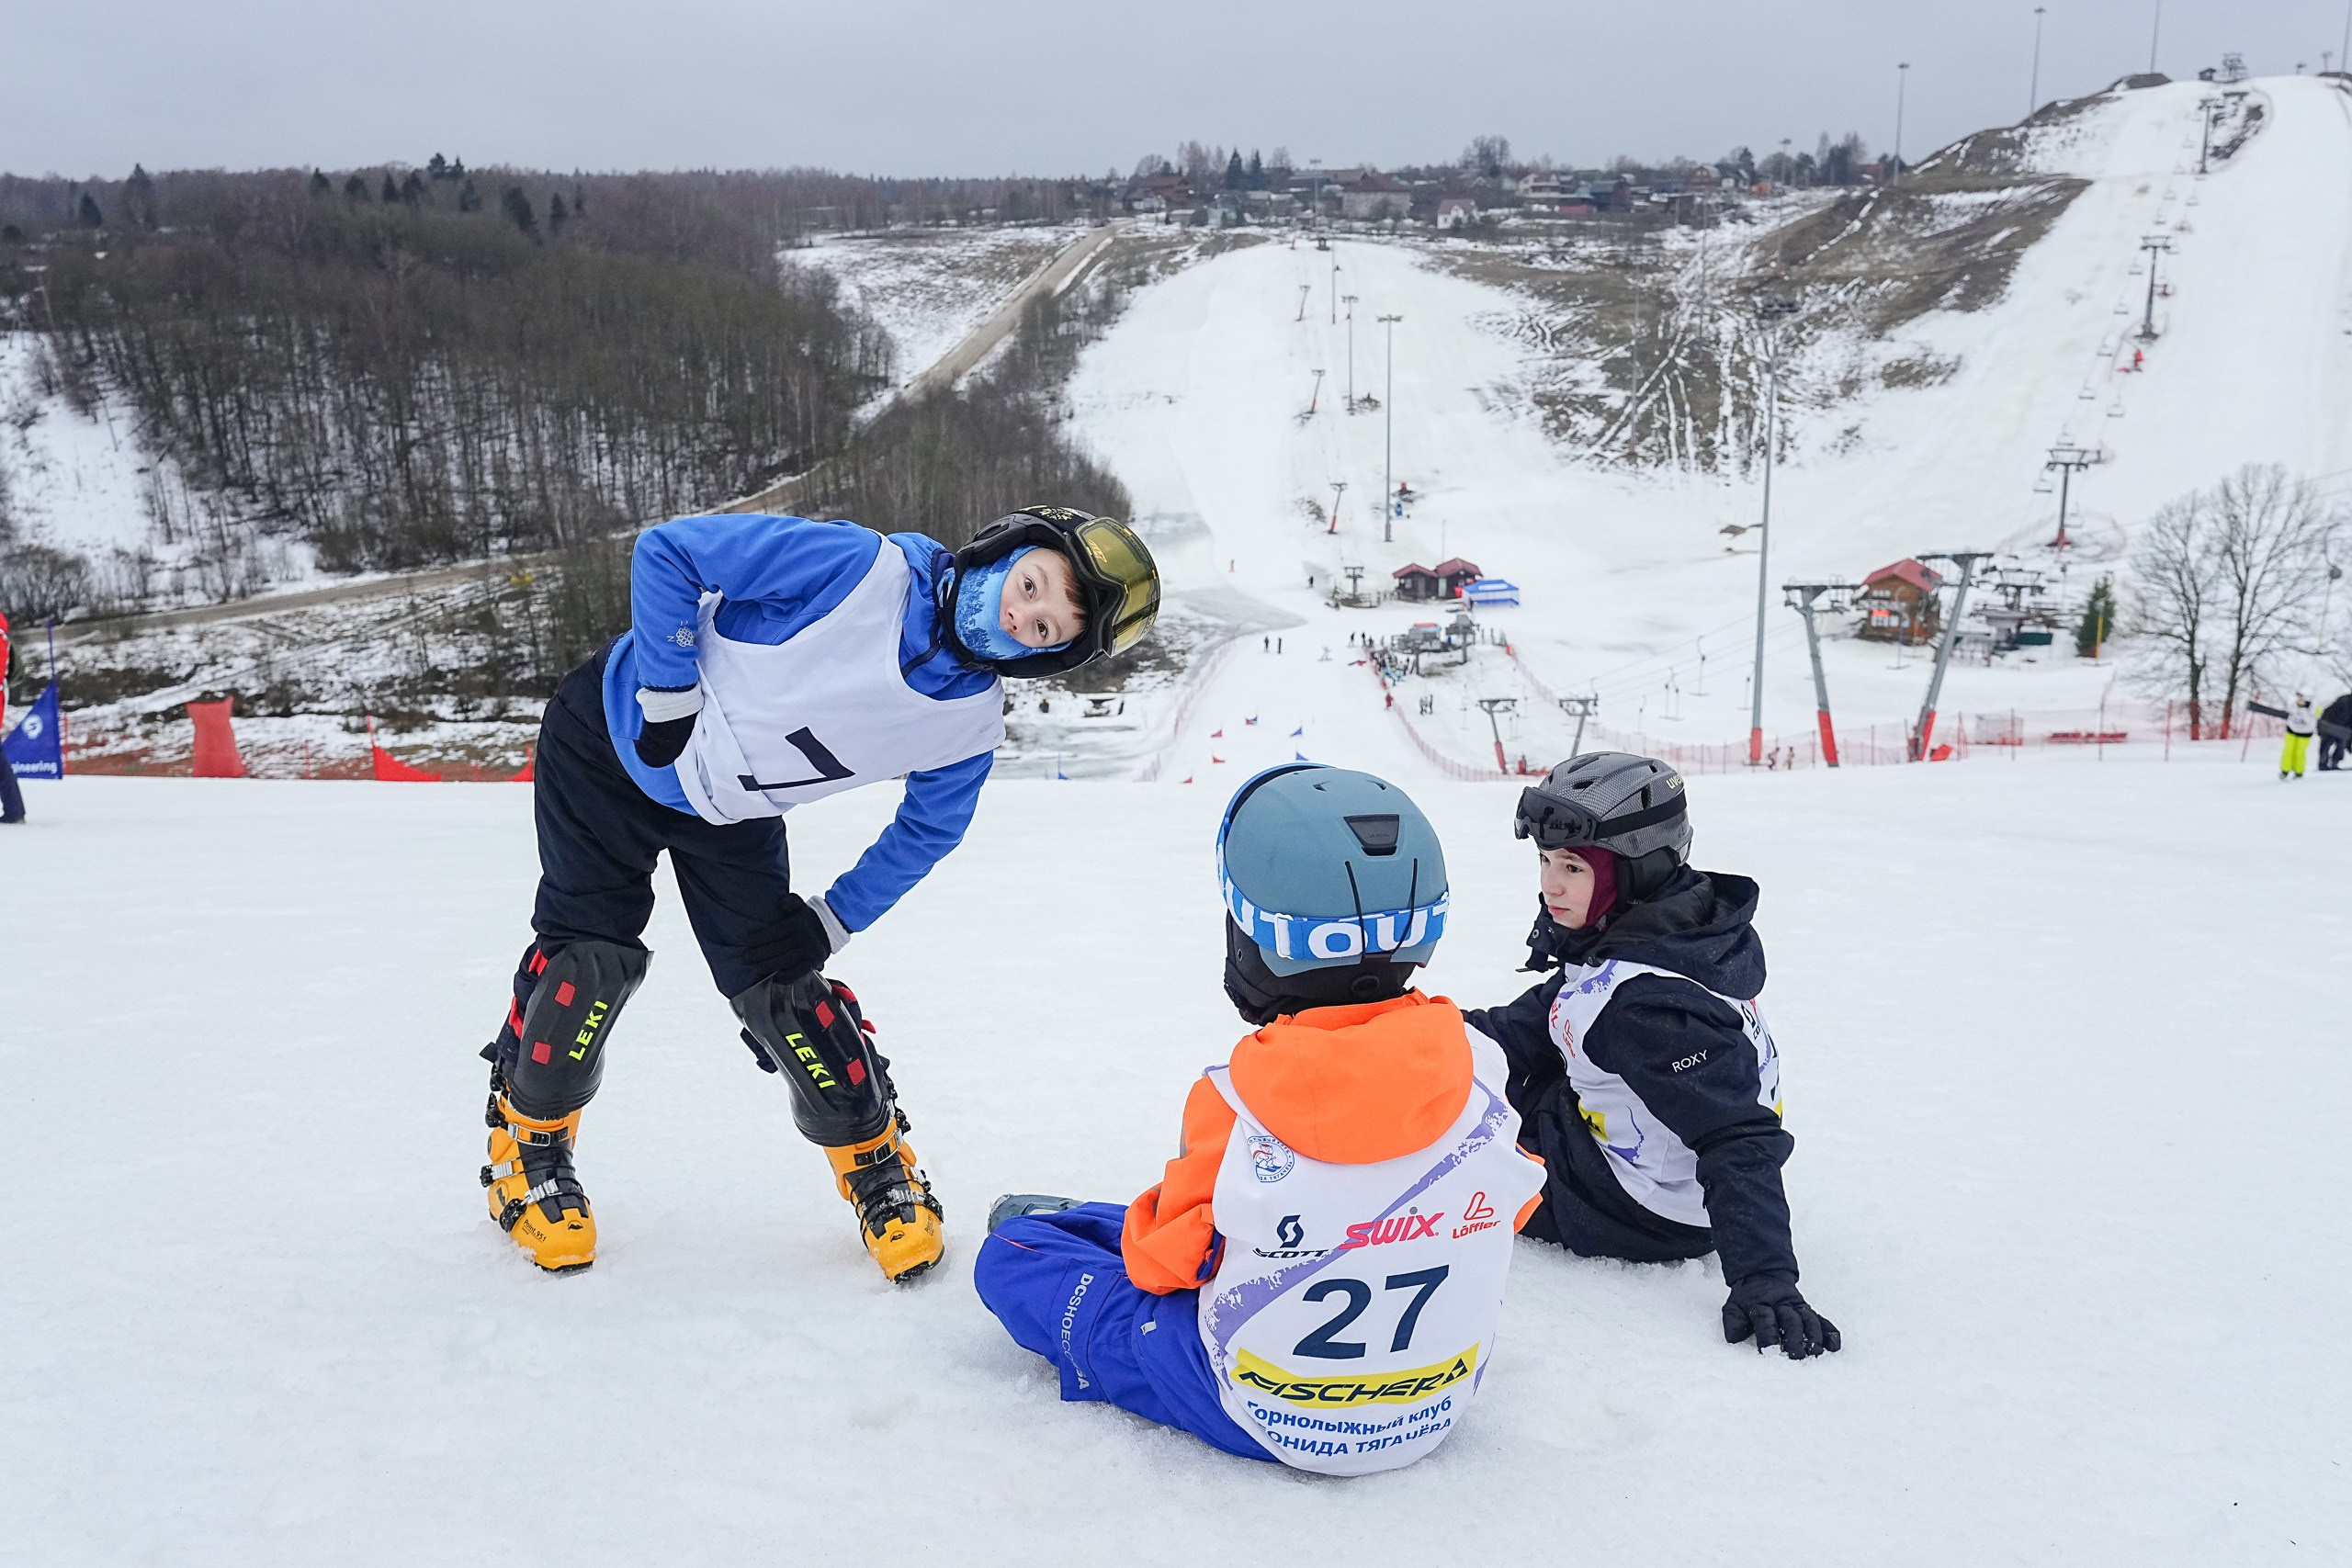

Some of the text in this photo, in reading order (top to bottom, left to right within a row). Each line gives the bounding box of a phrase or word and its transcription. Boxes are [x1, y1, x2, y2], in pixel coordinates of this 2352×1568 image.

[1666, 773, 1684, 789] uve
[569, 1000, 608, 1061] LEKI
[785, 1032, 836, 1089] LEKI
[1672, 1049, 1707, 1073] ROXY
[1253, 1247, 1329, 1258] SCOTT
[1293, 1264, 1450, 1359] 27
[1238, 1371, 1445, 1402] FISCHER
[1408, 1395, 1452, 1424] клуб
[1266, 1429, 1349, 1457] ОНИДА
